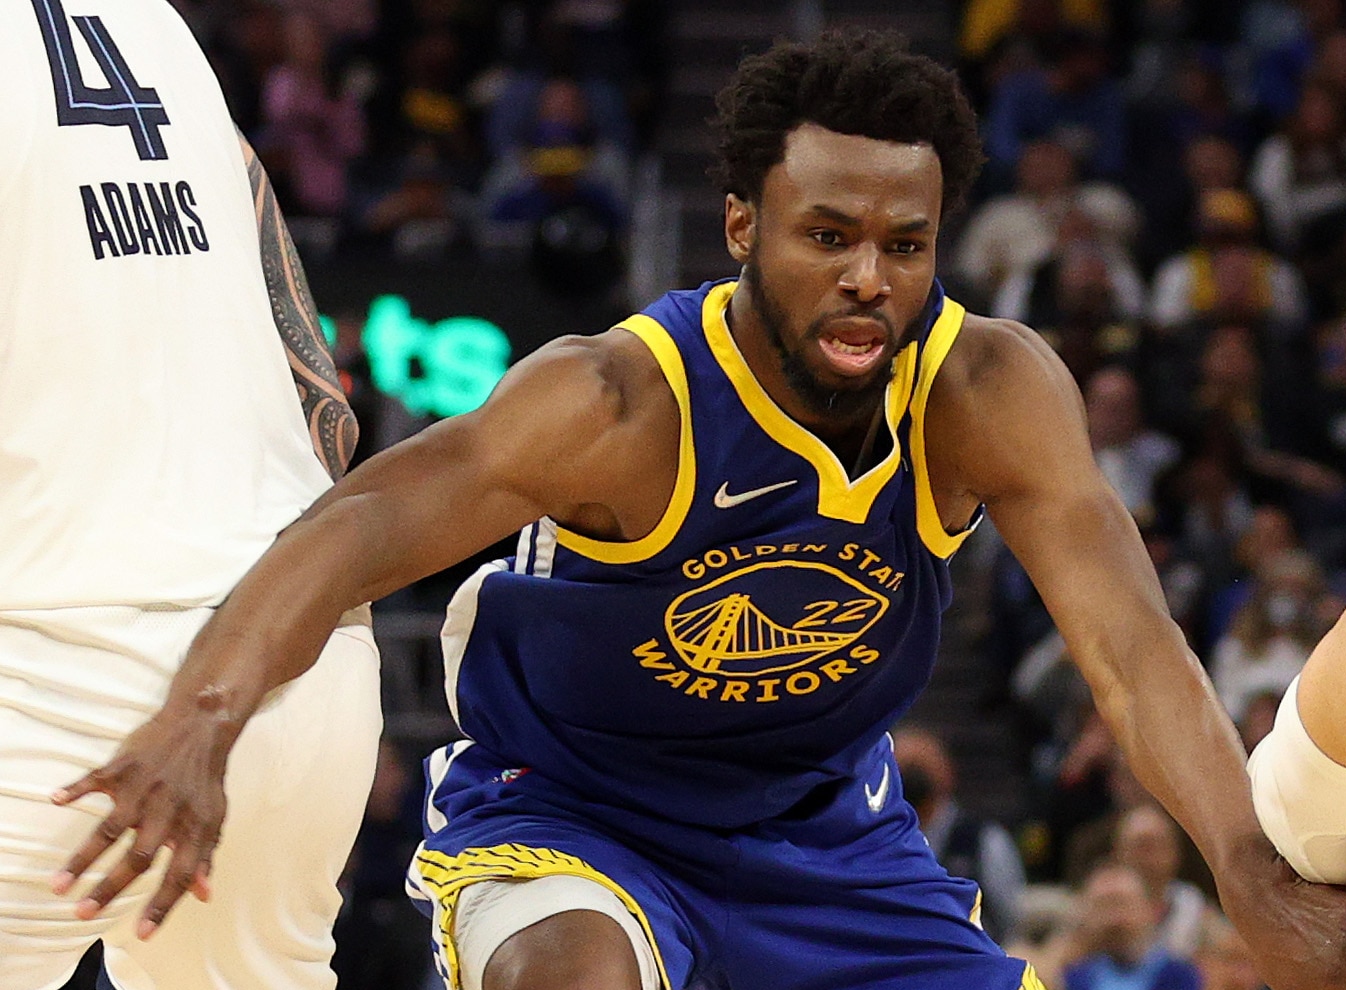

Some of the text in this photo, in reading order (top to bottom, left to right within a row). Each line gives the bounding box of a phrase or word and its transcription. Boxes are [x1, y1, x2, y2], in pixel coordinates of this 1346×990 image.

[31, 0, 171, 161] 4
[79, 180, 210, 260] ADAMS
[318, 293, 512, 419] ts
[681, 542, 828, 580] GOLDEN
[791, 599, 878, 630] 22
[631, 637, 881, 703] WARRIORS
